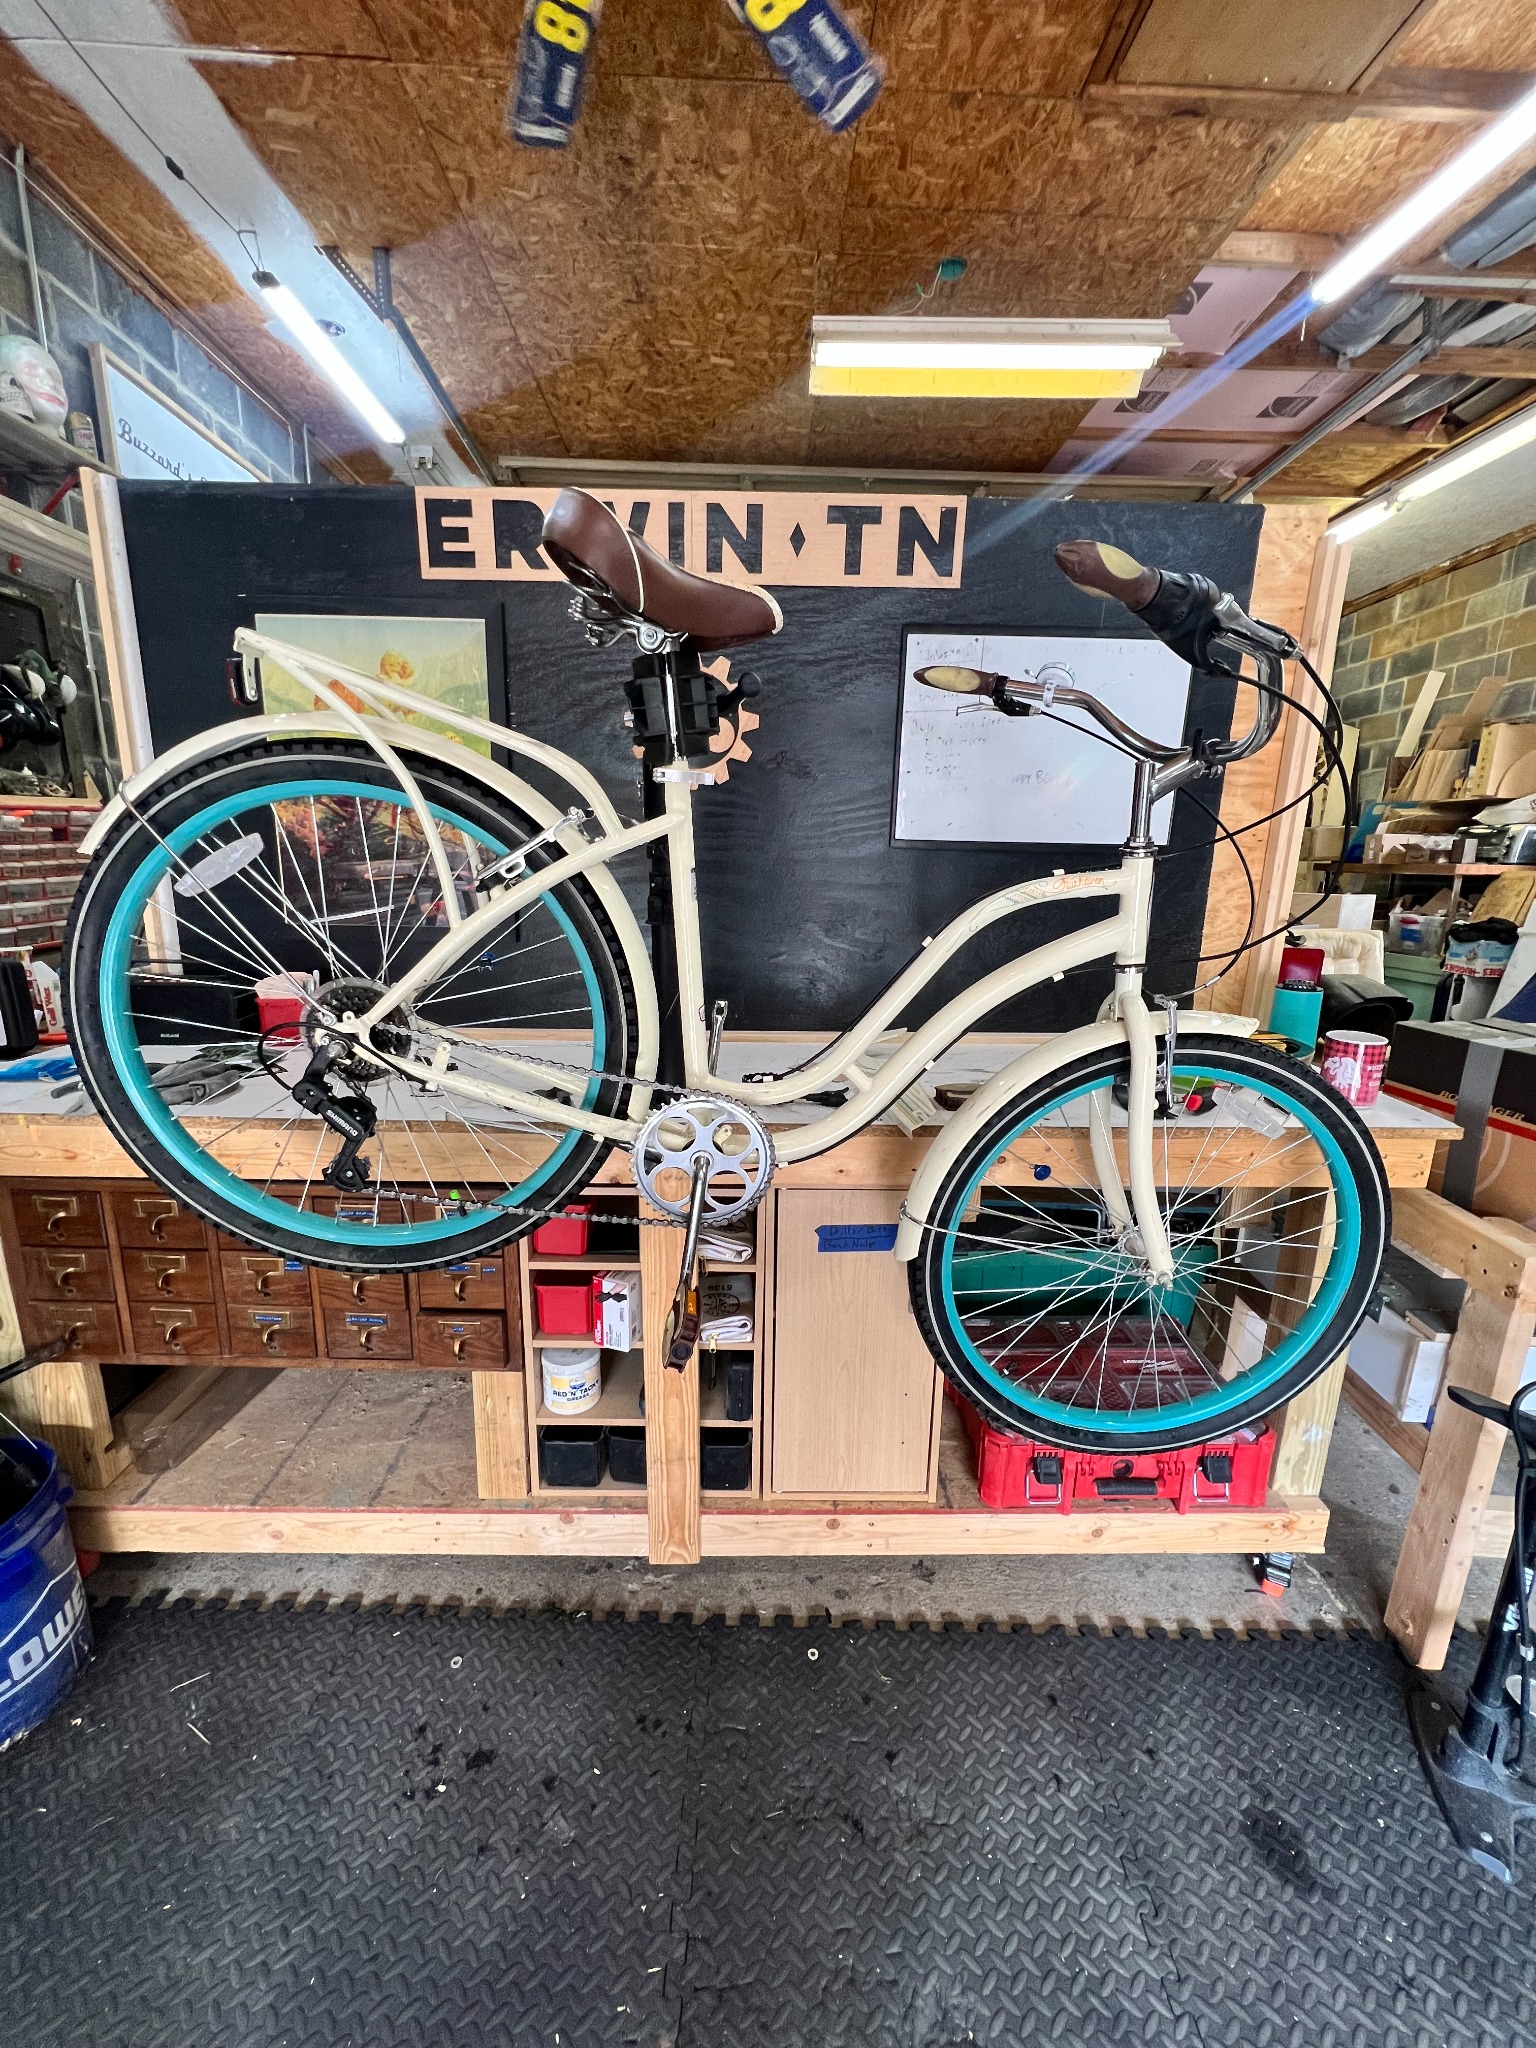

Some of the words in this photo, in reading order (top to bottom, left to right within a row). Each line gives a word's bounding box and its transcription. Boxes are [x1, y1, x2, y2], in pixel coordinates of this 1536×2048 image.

[827, 505, 958, 577] TN
[1059, 876, 1105, 891] Fairhaven
[325, 1109, 359, 1137] SHIMANO
[553, 1390, 568, 1398] RED
